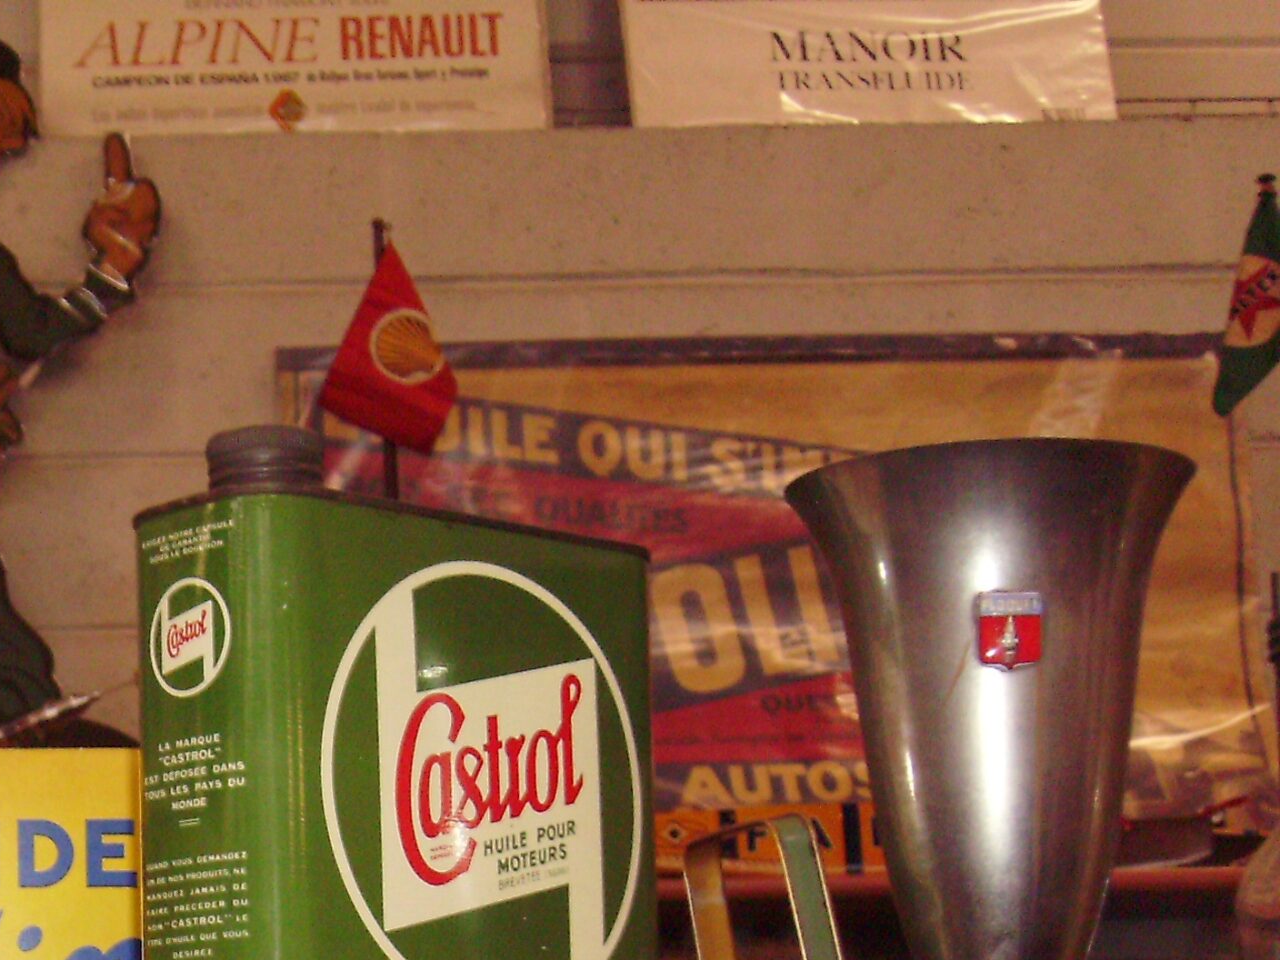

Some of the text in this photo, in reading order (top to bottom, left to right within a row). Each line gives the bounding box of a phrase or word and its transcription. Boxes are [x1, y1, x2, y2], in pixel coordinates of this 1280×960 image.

[73, 12, 504, 68] ALPINE RENAULT
[770, 30, 969, 63] MANOIR
[174, 73, 196, 86] DE
[777, 70, 972, 92] TRANSFLUIDE
[577, 421, 687, 482] QUI
[167, 609, 207, 658] Castrol
[158, 733, 221, 752] LA MARQUE
[144, 775, 160, 786] EST
[213, 761, 246, 773] DANS
[396, 674, 584, 886] Castrol
[145, 777, 245, 800] TOUS LES PAYS DU
[171, 797, 208, 811] MONDE
[484, 820, 576, 856] HUILE POUR
[172, 858, 193, 866] VOUS
[197, 851, 248, 863] DEMANDEZ
[497, 844, 567, 875] MOTEURS
[233, 867, 247, 875] NE
[190, 885, 227, 896] JAMAIS
[232, 882, 248, 891] DE
[232, 899, 249, 907] DU
[200, 931, 217, 941] QUE
[223, 930, 249, 938] VOUS
